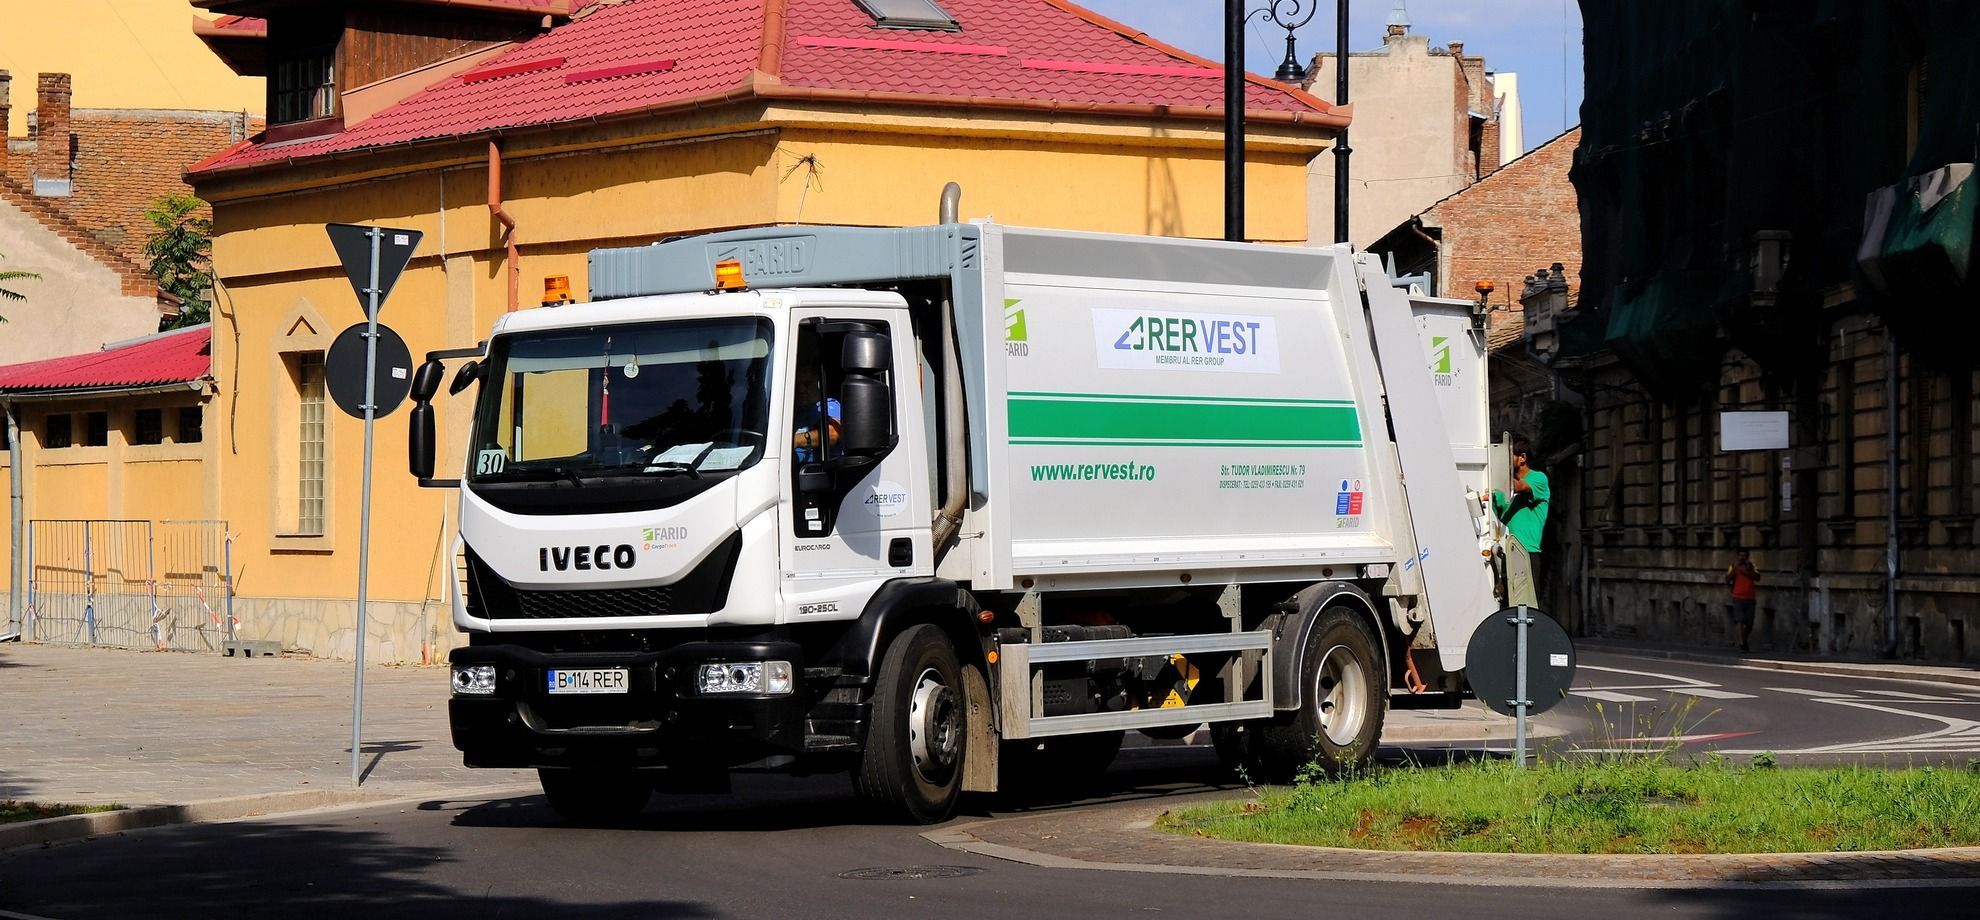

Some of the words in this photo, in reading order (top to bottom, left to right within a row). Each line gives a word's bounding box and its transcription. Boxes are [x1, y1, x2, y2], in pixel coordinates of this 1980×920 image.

[744, 240, 805, 276] FARID
[1147, 316, 1198, 352] RER
[1200, 319, 1260, 355] VEST
[1155, 355, 1181, 364] MEMBRU
[1182, 356, 1190, 365] AL
[1191, 356, 1203, 365] RER
[1204, 357, 1225, 366] GROUP
[1434, 374, 1452, 386] FARID
[479, 453, 502, 475] 30
[1030, 460, 1156, 481] www.rervest.ro
[1231, 464, 1250, 476] TUDOR
[1250, 464, 1289, 476] VLADIMIRESCU
[873, 494, 888, 504] RER
[888, 493, 906, 503] VEST
[1342, 517, 1360, 528] FARID
[654, 527, 688, 541] FARID
[795, 544, 831, 552] EUROCARGO
[539, 544, 637, 571] IVECO
[799, 604, 838, 614] 190-250L
[594, 672, 623, 688] RER
